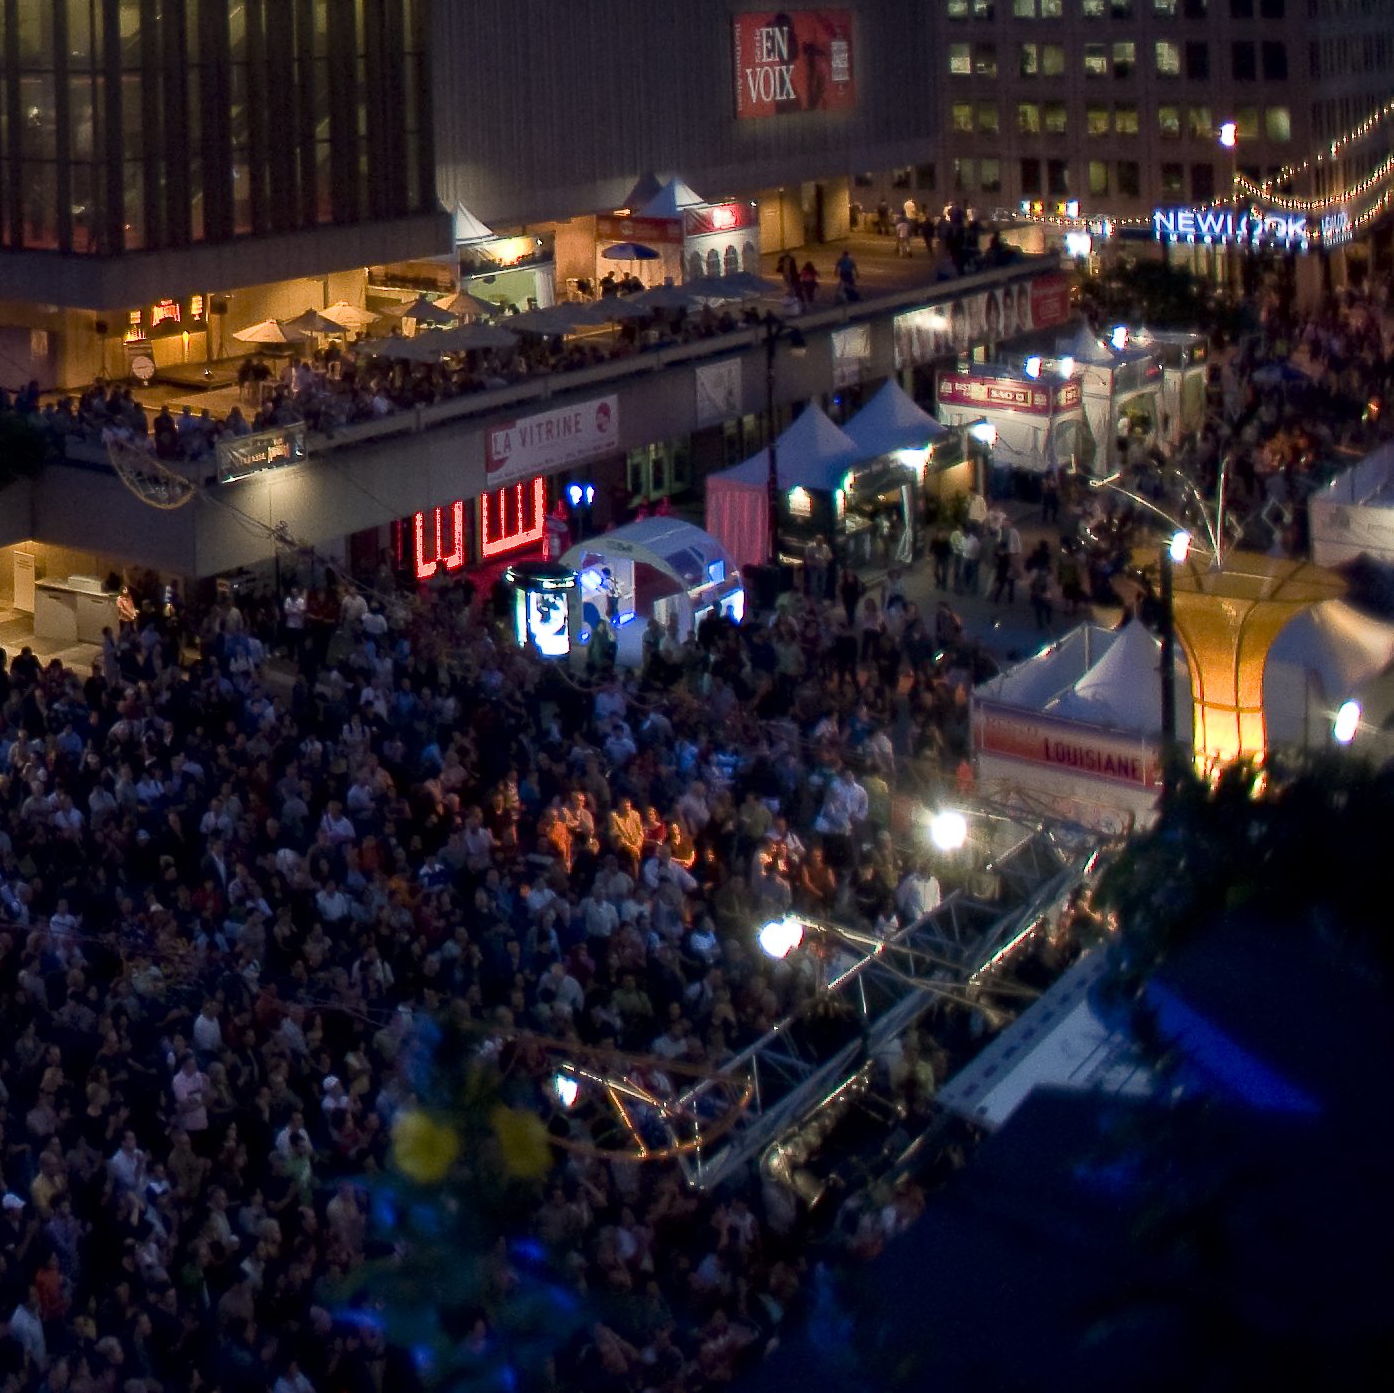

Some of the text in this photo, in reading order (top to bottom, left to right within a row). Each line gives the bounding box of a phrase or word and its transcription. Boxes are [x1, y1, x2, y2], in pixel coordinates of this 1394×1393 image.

[760, 26, 790, 63] EN
[745, 64, 797, 103] VOIX
[492, 412, 582, 455] LA VITRINE
[1043, 727, 1142, 780] LOUISIANE
